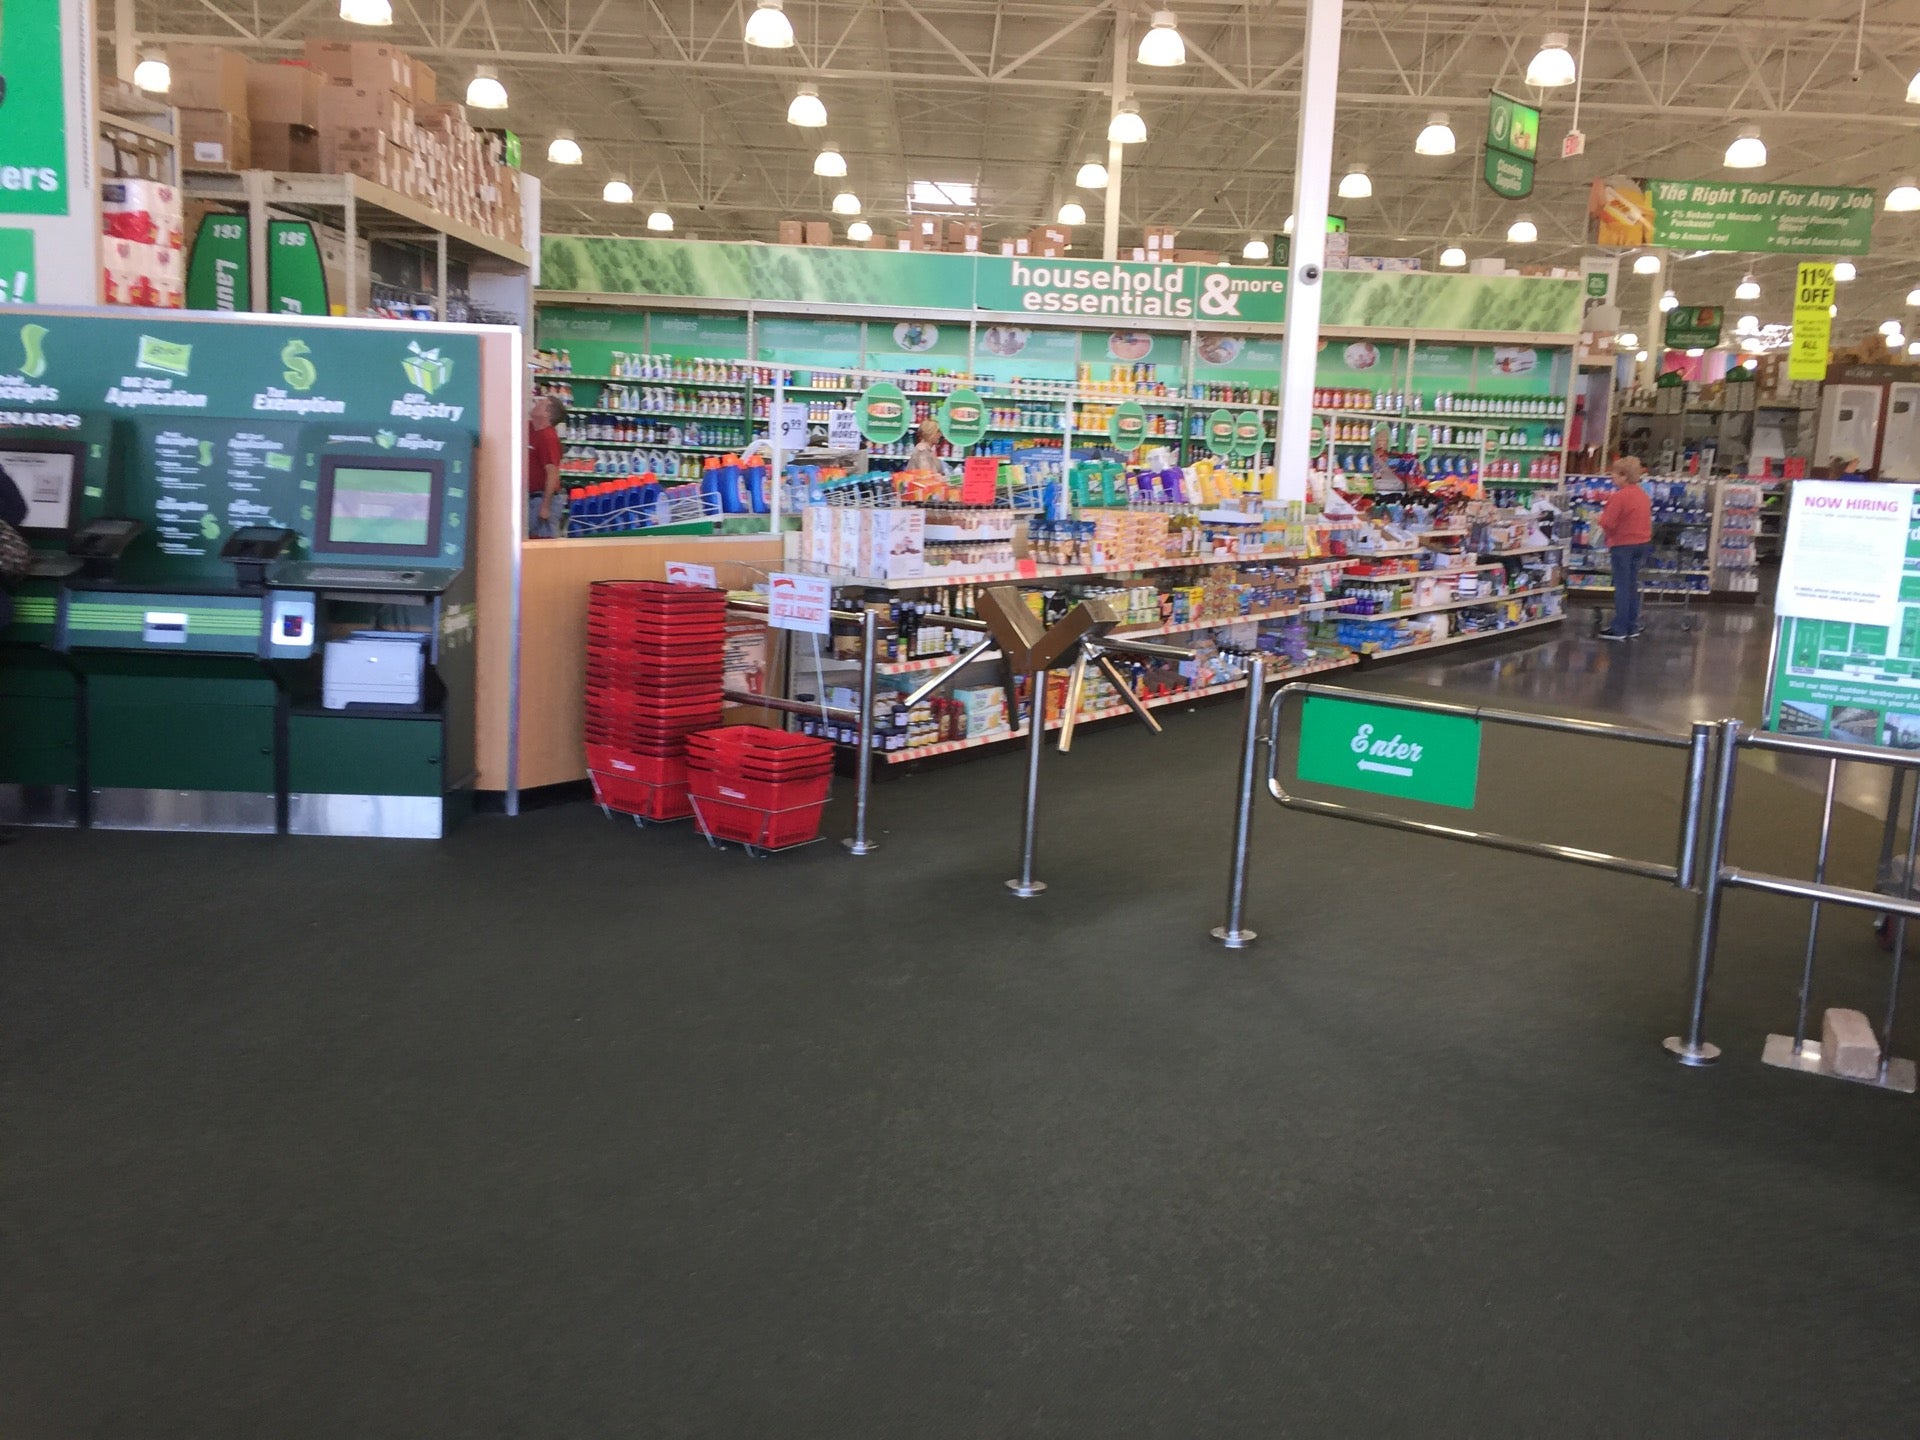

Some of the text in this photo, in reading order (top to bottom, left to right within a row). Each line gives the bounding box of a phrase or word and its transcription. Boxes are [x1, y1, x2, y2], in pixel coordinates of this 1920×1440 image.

[1659, 185, 1873, 211] The Right Tool For Any Job
[213, 224, 242, 239] 193
[279, 231, 307, 246] 195
[1011, 260, 1183, 293] household
[1801, 268, 1834, 286] 11%
[1022, 290, 1193, 317] essentials
[1199, 273, 1284, 316] & more
[1801, 288, 1830, 303] OFF
[104, 387, 208, 408] Application
[391, 400, 464, 421] Registry
[1804, 496, 1899, 513] NOW HIRING
[1350, 723, 1423, 762] Enter
